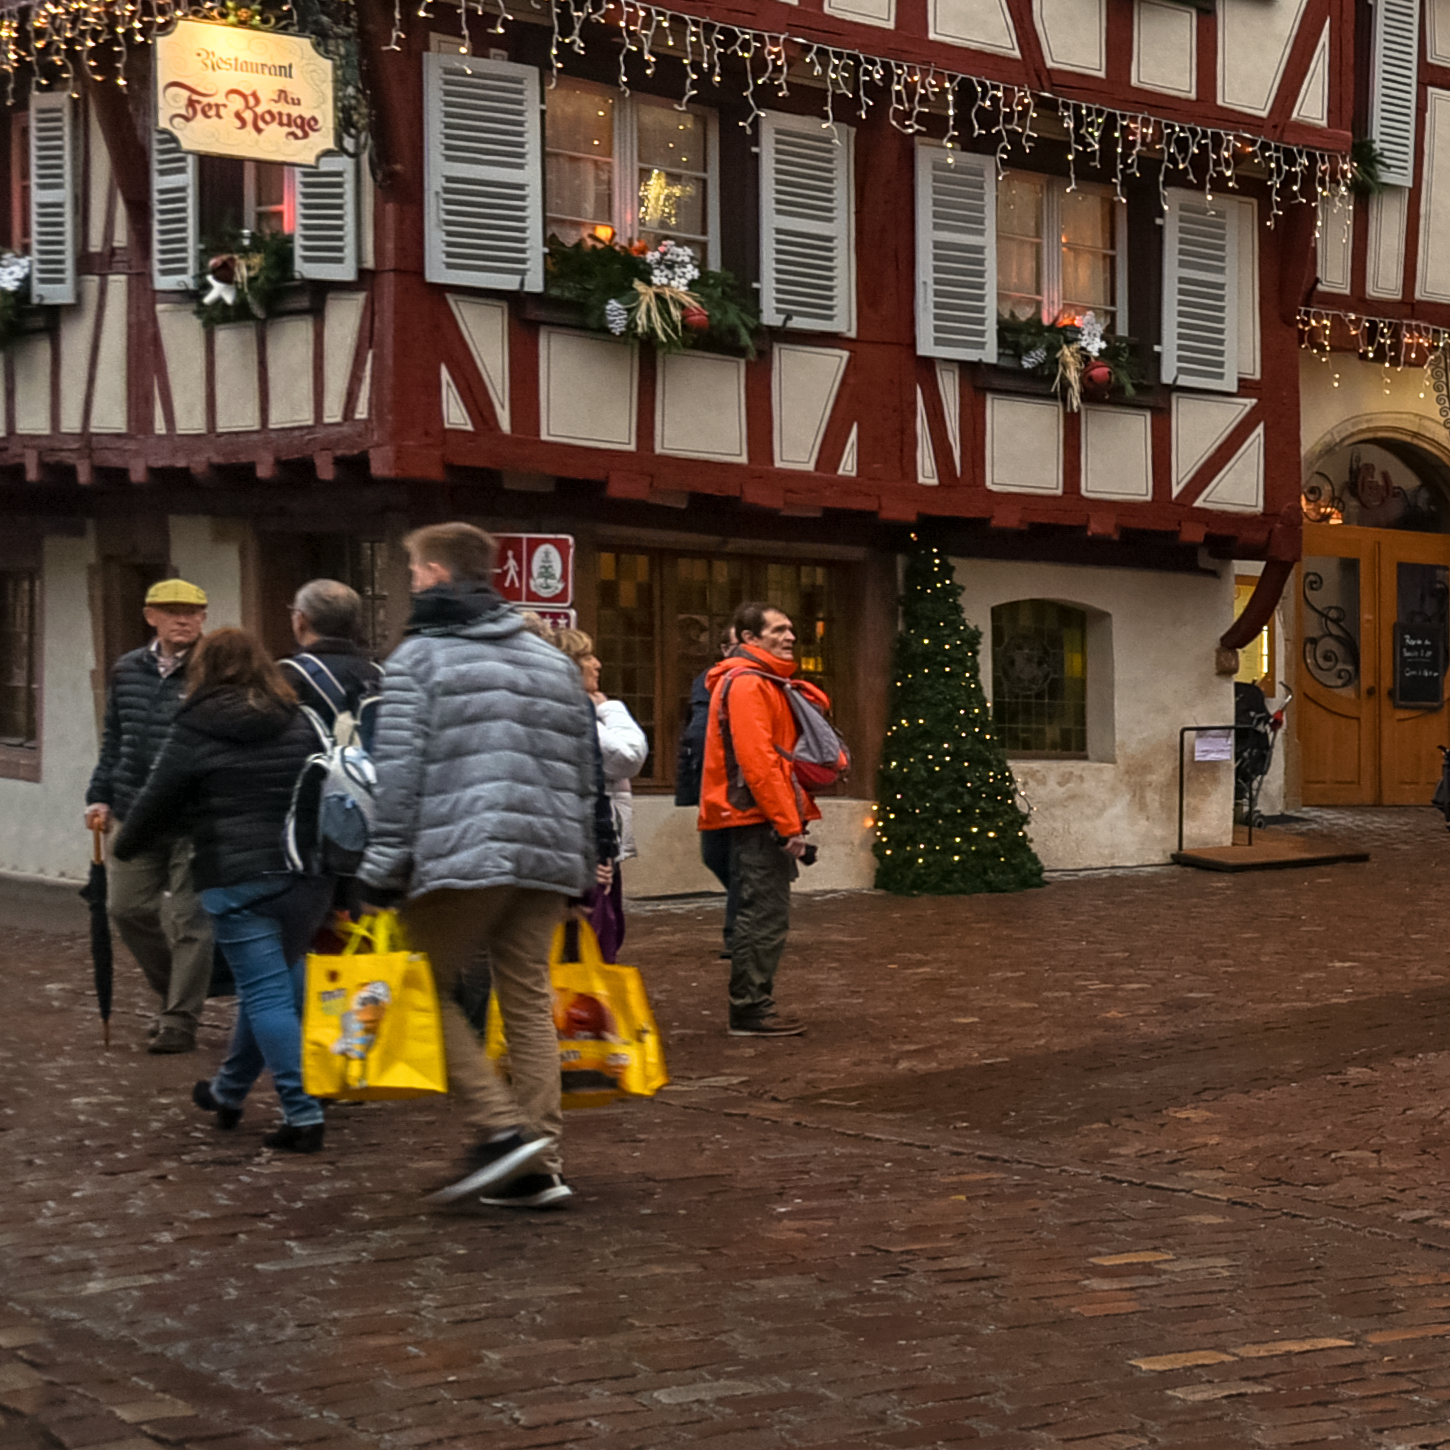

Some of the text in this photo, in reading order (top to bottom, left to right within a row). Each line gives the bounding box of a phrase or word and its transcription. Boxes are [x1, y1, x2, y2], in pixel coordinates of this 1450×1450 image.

[196, 48, 294, 79] Restaurant
[163, 81, 323, 140] Fer Rouge
[270, 89, 302, 106] Au
